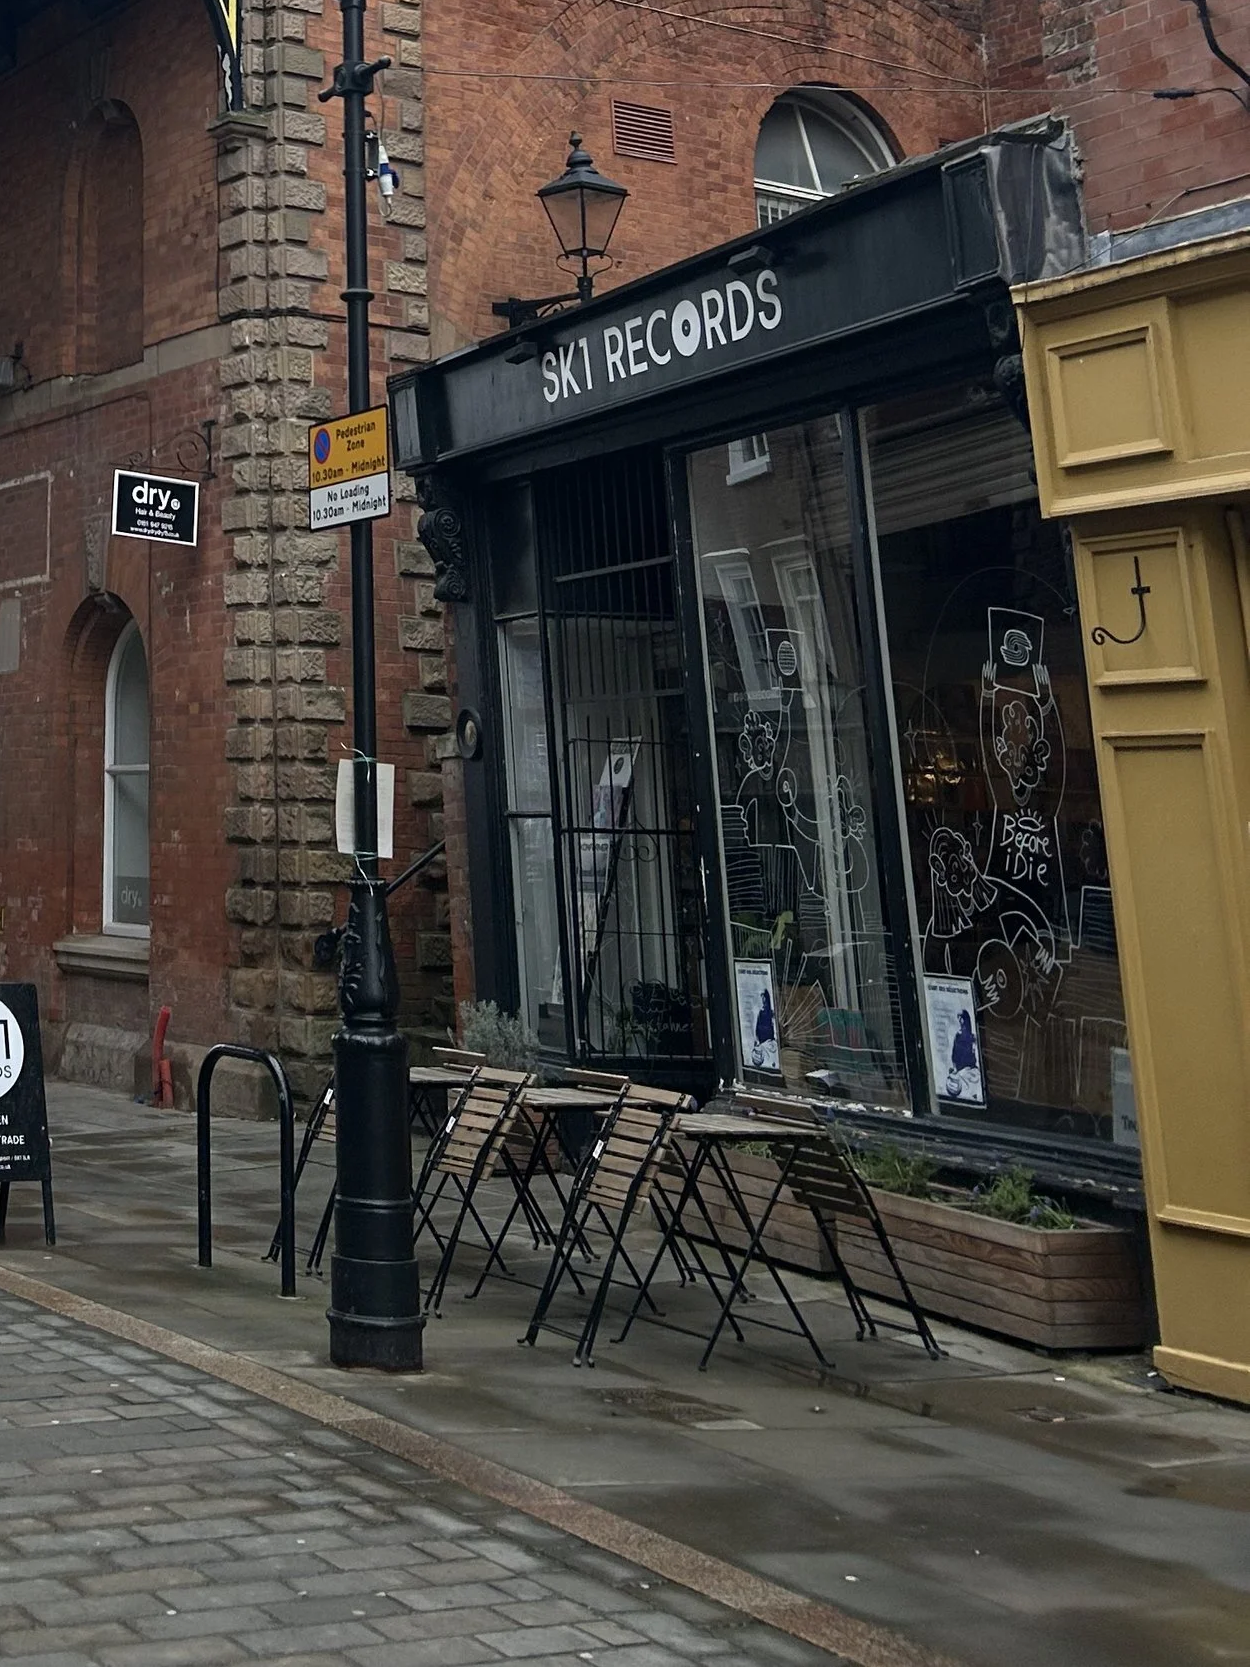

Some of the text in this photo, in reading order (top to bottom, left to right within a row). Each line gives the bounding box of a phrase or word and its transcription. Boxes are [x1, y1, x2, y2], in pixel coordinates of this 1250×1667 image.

[541, 269, 783, 403] SK1 RECORDS
[336, 421, 376, 441] Pedestrian
[346, 438, 365, 452] Zone
[312, 467, 344, 483] 10.30am
[351, 456, 385, 473] Midnight
[132, 480, 171, 511] dry
[327, 484, 370, 502] No Loading
[135, 507, 176, 521] Hair & Beauty
[312, 506, 345, 522] 10.30am
[352, 495, 386, 513] Midnight
[1000, 814, 1053, 858] Before
[1012, 852, 1049, 887] Die
